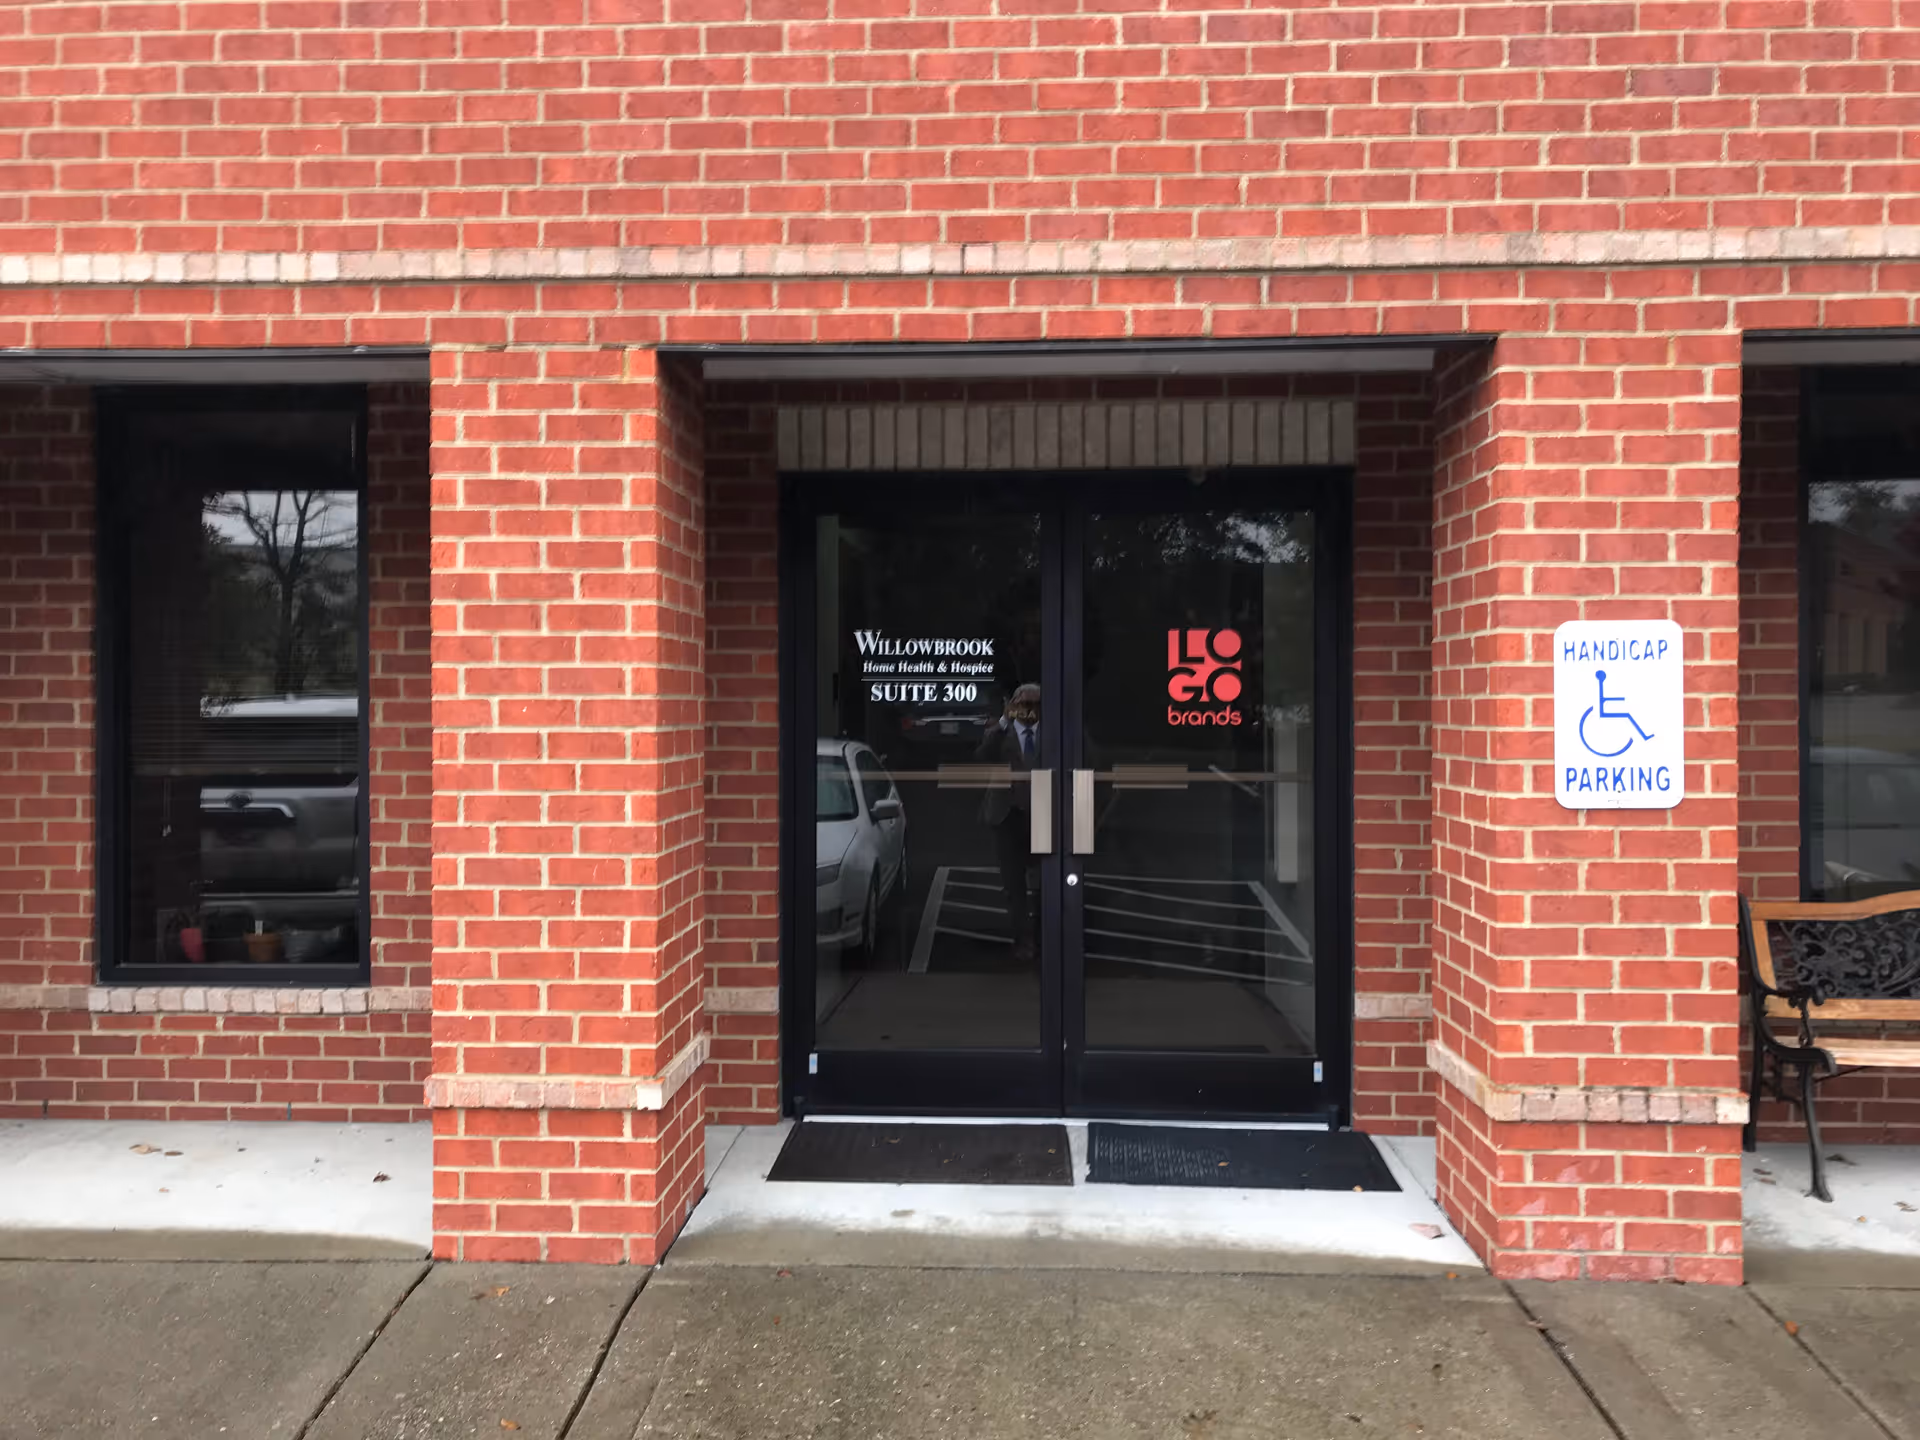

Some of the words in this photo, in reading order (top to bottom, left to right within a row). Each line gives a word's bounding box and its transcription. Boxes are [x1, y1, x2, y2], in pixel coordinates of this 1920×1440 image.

[853, 629, 994, 656] WILLOWBROOK
[1564, 639, 1668, 662] HANDICAP
[863, 660, 895, 673] Home
[898, 660, 935, 673] Health
[937, 661, 948, 673] &
[951, 660, 994, 675] Hospice
[870, 683, 938, 702] SUITE
[943, 683, 977, 702] 300
[1167, 704, 1242, 726] brands
[1566, 766, 1671, 792] PARKING
